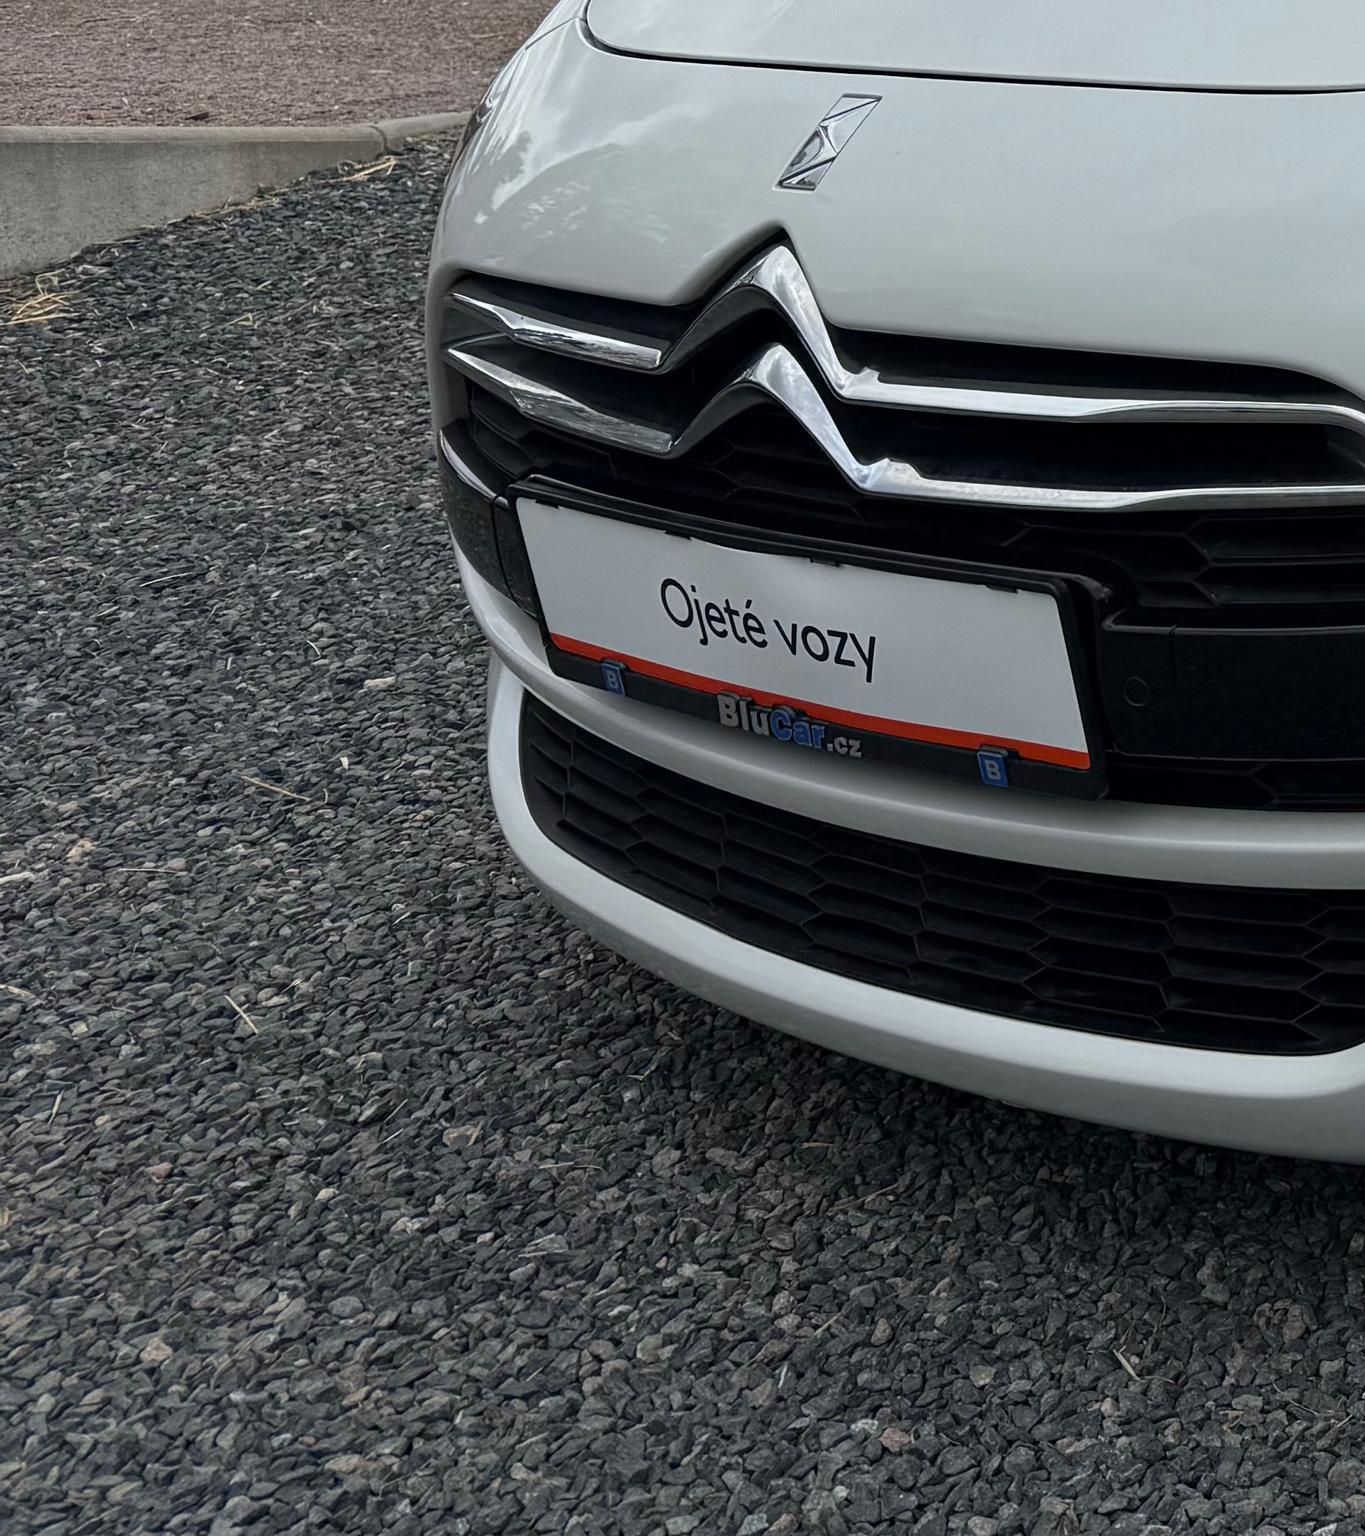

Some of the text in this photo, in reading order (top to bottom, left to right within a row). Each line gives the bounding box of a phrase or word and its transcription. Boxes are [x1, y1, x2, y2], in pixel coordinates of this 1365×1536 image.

[660, 577, 877, 683] Ojeté vozy
[717, 692, 862, 759] BluCar.cz
